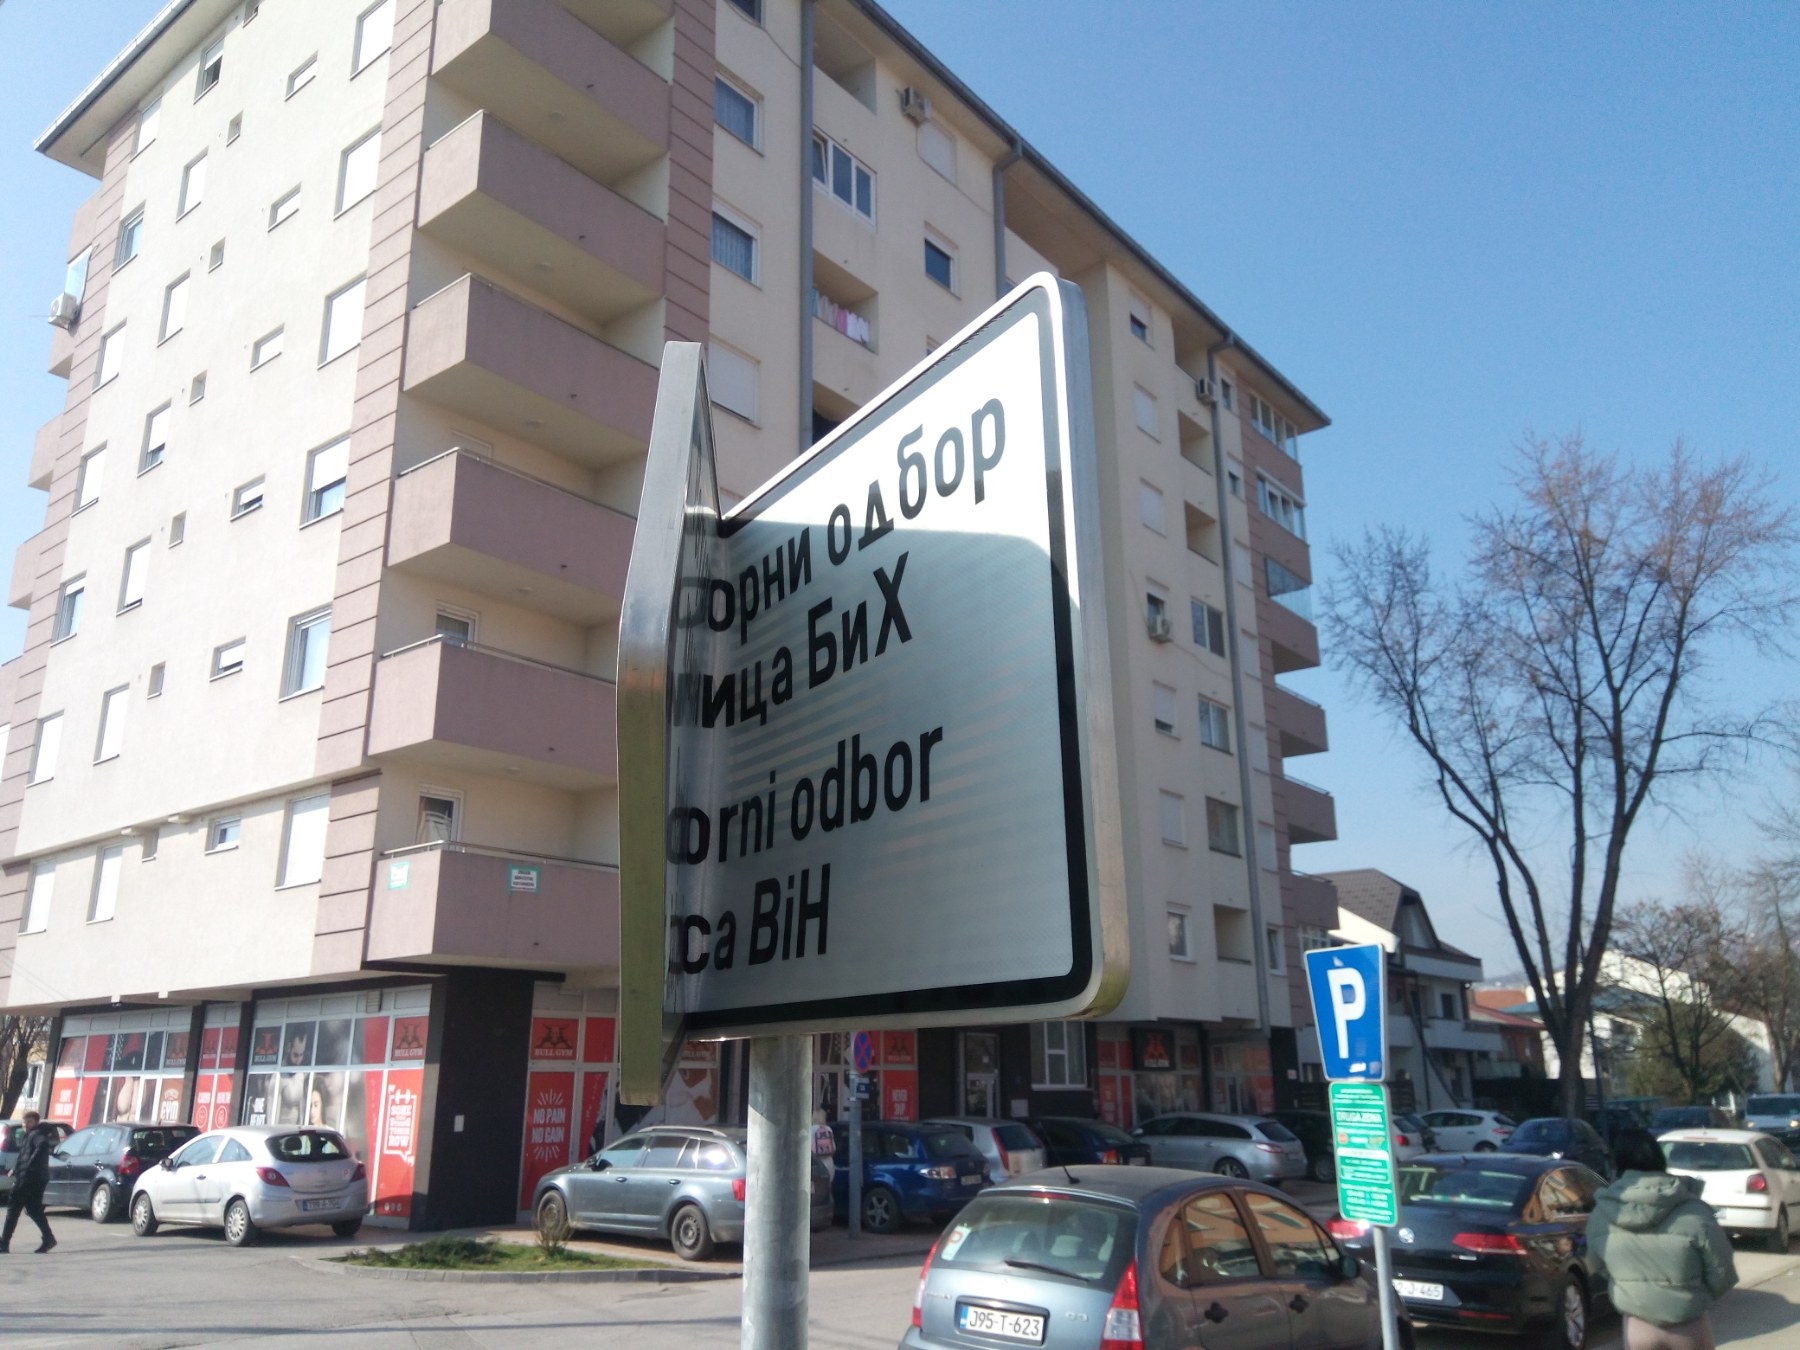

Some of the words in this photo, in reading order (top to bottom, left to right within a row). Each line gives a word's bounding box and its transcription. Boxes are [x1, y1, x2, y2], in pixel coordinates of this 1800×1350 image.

[827, 398, 1006, 566] одбор
[808, 551, 912, 690] БиХ
[790, 726, 944, 842] odbor
[748, 863, 832, 966] BiH
[534, 1049, 554, 1057] BULL
[555, 1049, 573, 1057] GYM
[1327, 967, 1367, 1060] P
[532, 1127, 544, 1144] NO
[544, 1127, 565, 1143] GAIN
[533, 1108, 545, 1124] NO
[546, 1108, 566, 1124] PAIN
[969, 1310, 1040, 1337] J95-T-623
